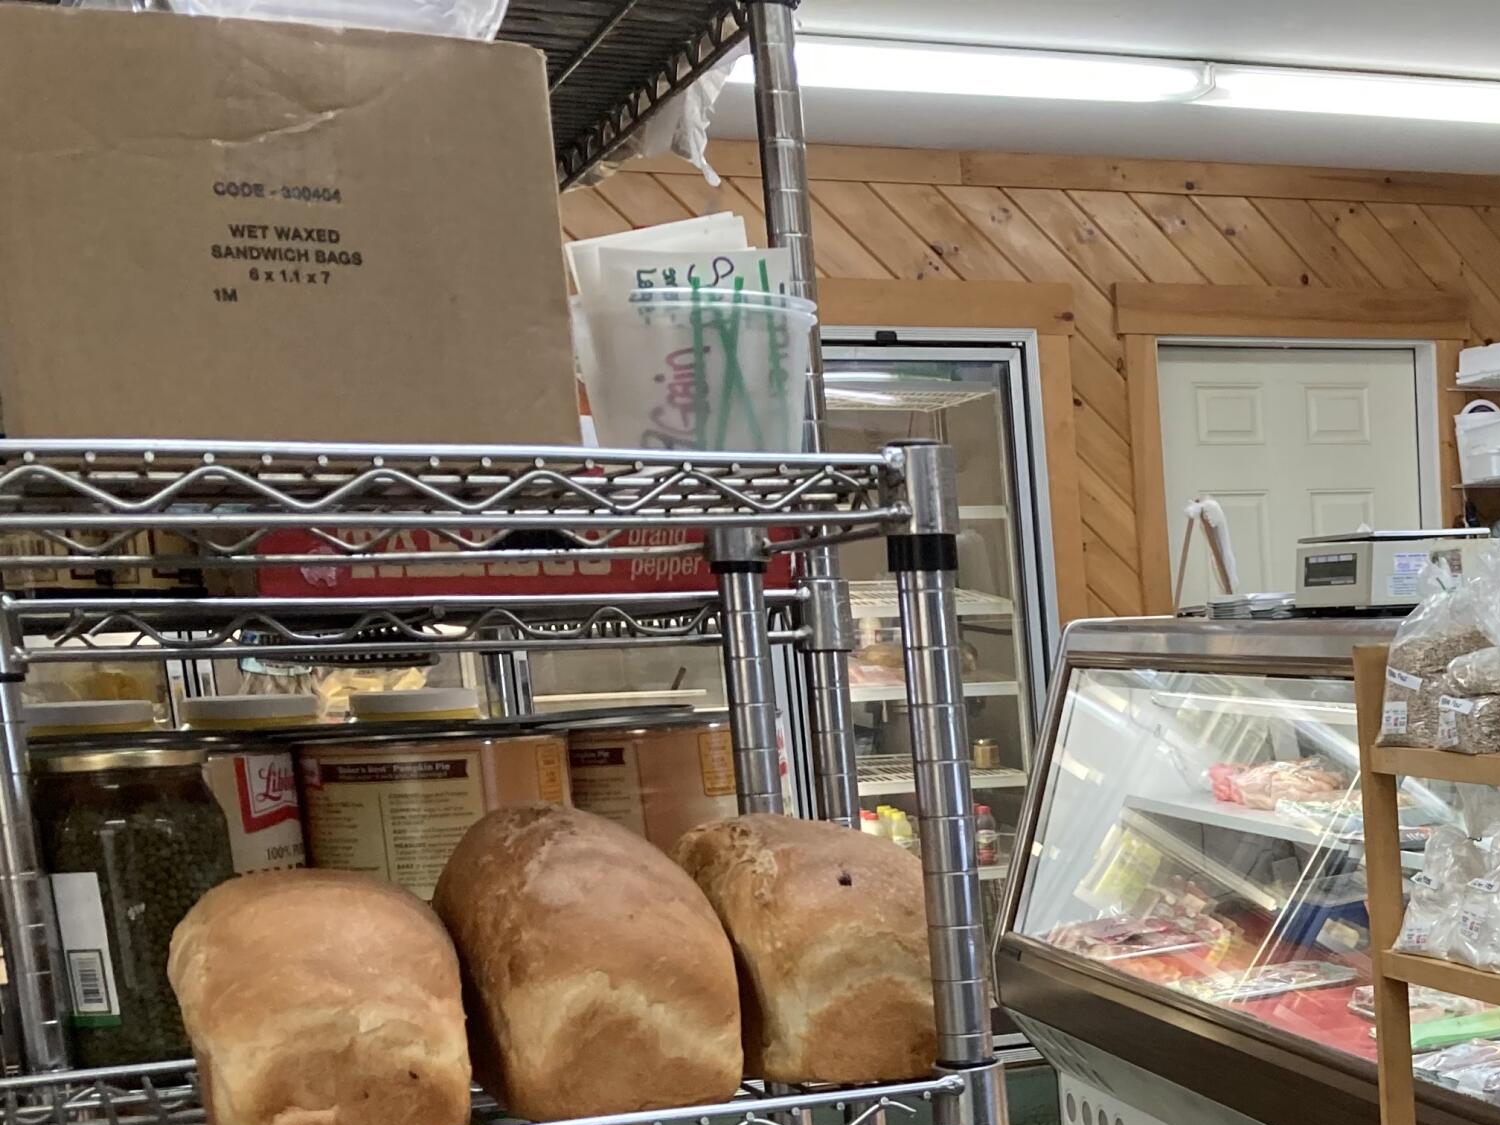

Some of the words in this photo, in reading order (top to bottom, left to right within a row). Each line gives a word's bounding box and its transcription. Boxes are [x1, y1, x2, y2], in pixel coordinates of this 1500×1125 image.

[212, 182, 264, 198] CODE
[229, 224, 269, 239] WET
[274, 226, 340, 244] WAXED
[211, 244, 309, 262] SANDWICH
[315, 250, 363, 266] BAGS
[249, 267, 260, 281] 6
[264, 270, 275, 282] x
[280, 269, 301, 283] 1.1
[307, 272, 317, 284] x
[320, 271, 331, 284] 7
[213, 288, 238, 302] 1M
[628, 528, 688, 545] brand
[630, 555, 703, 581] pepper
